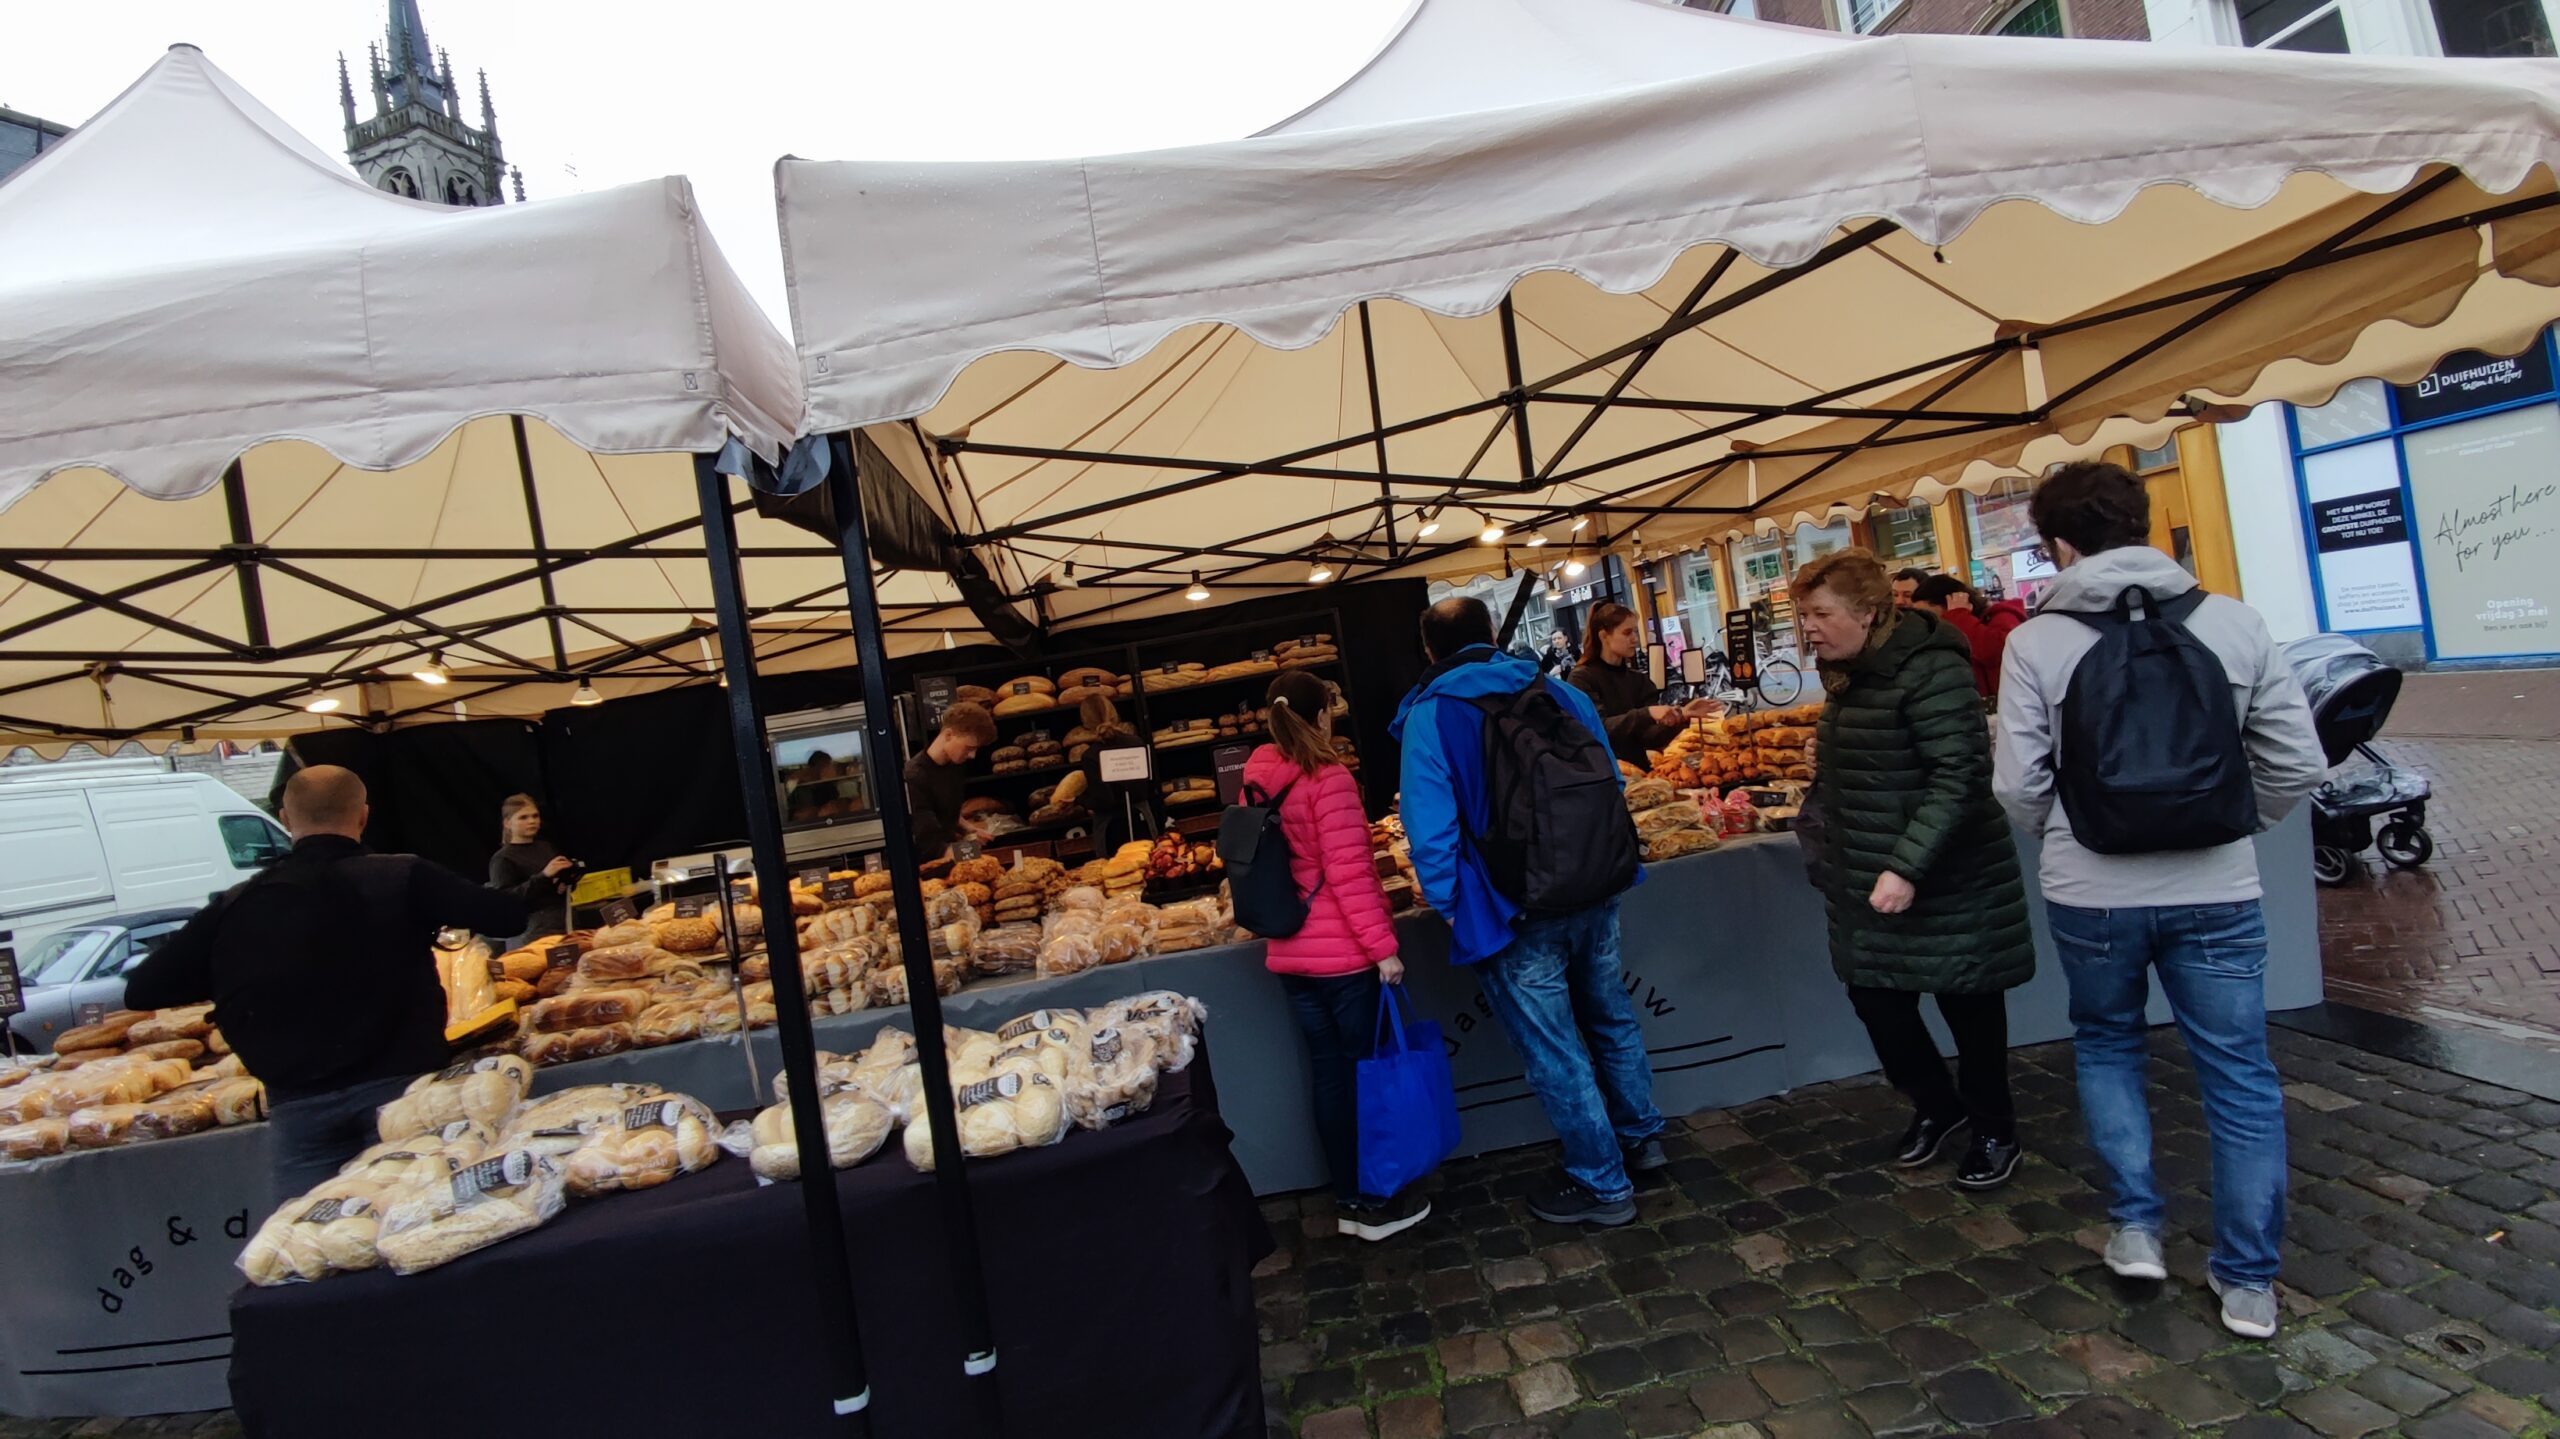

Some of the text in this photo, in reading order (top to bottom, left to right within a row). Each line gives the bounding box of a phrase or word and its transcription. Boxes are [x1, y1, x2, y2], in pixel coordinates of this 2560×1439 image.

[2441, 358, 2515, 386] DUIFHUIZEN
[2332, 515, 2350, 524] DEZE
[2377, 508, 2388, 517] DE
[2360, 515, 2402, 528] DUIFHUIZEN
[2433, 484, 2556, 546] Almost here
[2341, 531, 2355, 539] TOT
[2355, 529, 2367, 537] NU
[2456, 540, 2484, 573] for
[2492, 527, 2530, 561] you
[2487, 597, 2534, 609] Opening
[2475, 605, 2548, 621] vrijdag 3 mei
[97, 1245, 153, 1314] dag
[167, 1216, 198, 1246] &
